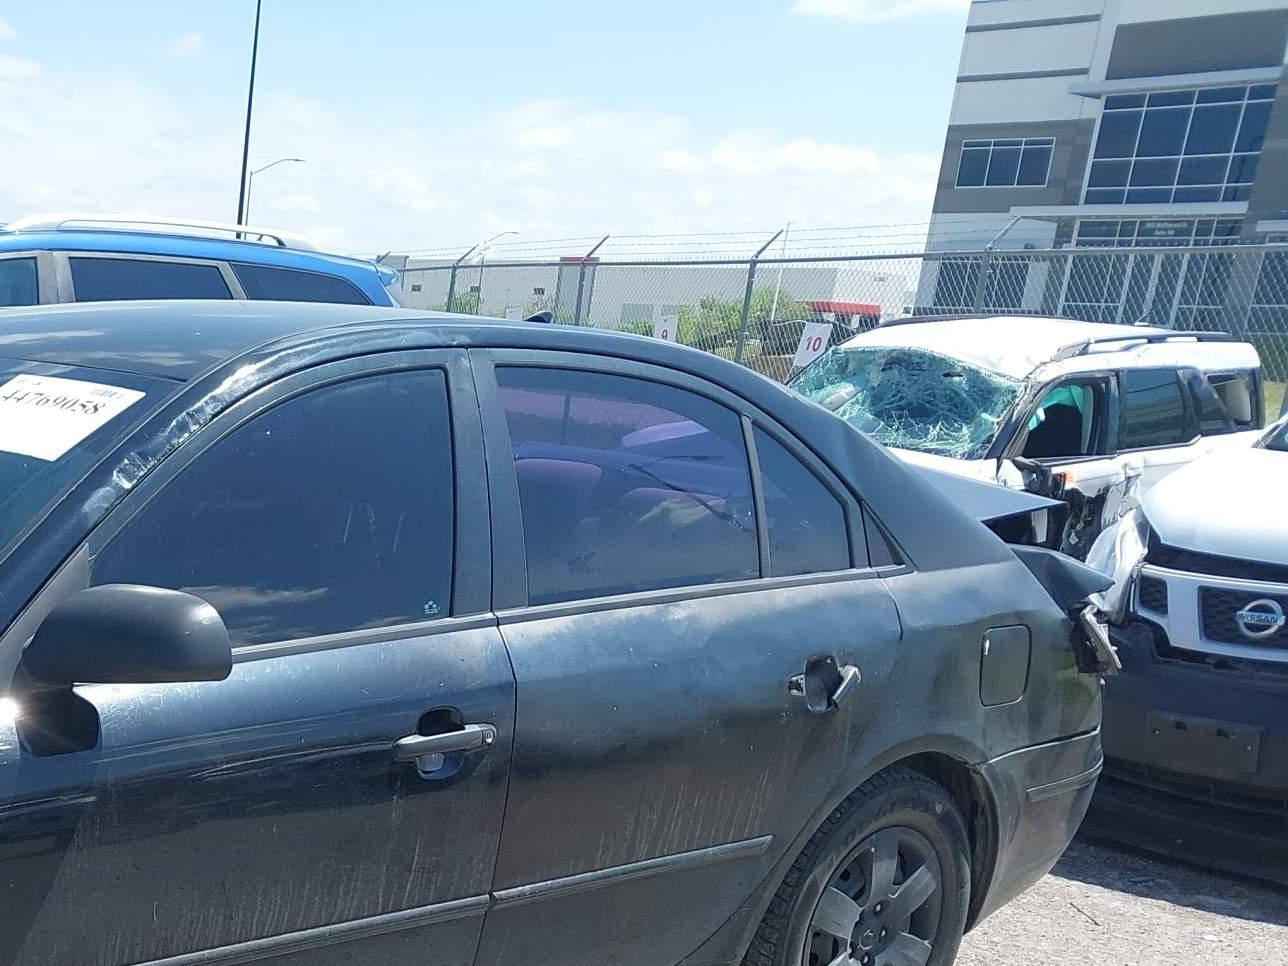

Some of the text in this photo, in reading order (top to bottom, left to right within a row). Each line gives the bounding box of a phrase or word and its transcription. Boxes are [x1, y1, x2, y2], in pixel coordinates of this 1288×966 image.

[806, 336, 822, 352] 10
[2, 389, 106, 414] 44769058
[1239, 613, 1279, 623] NISSAN
